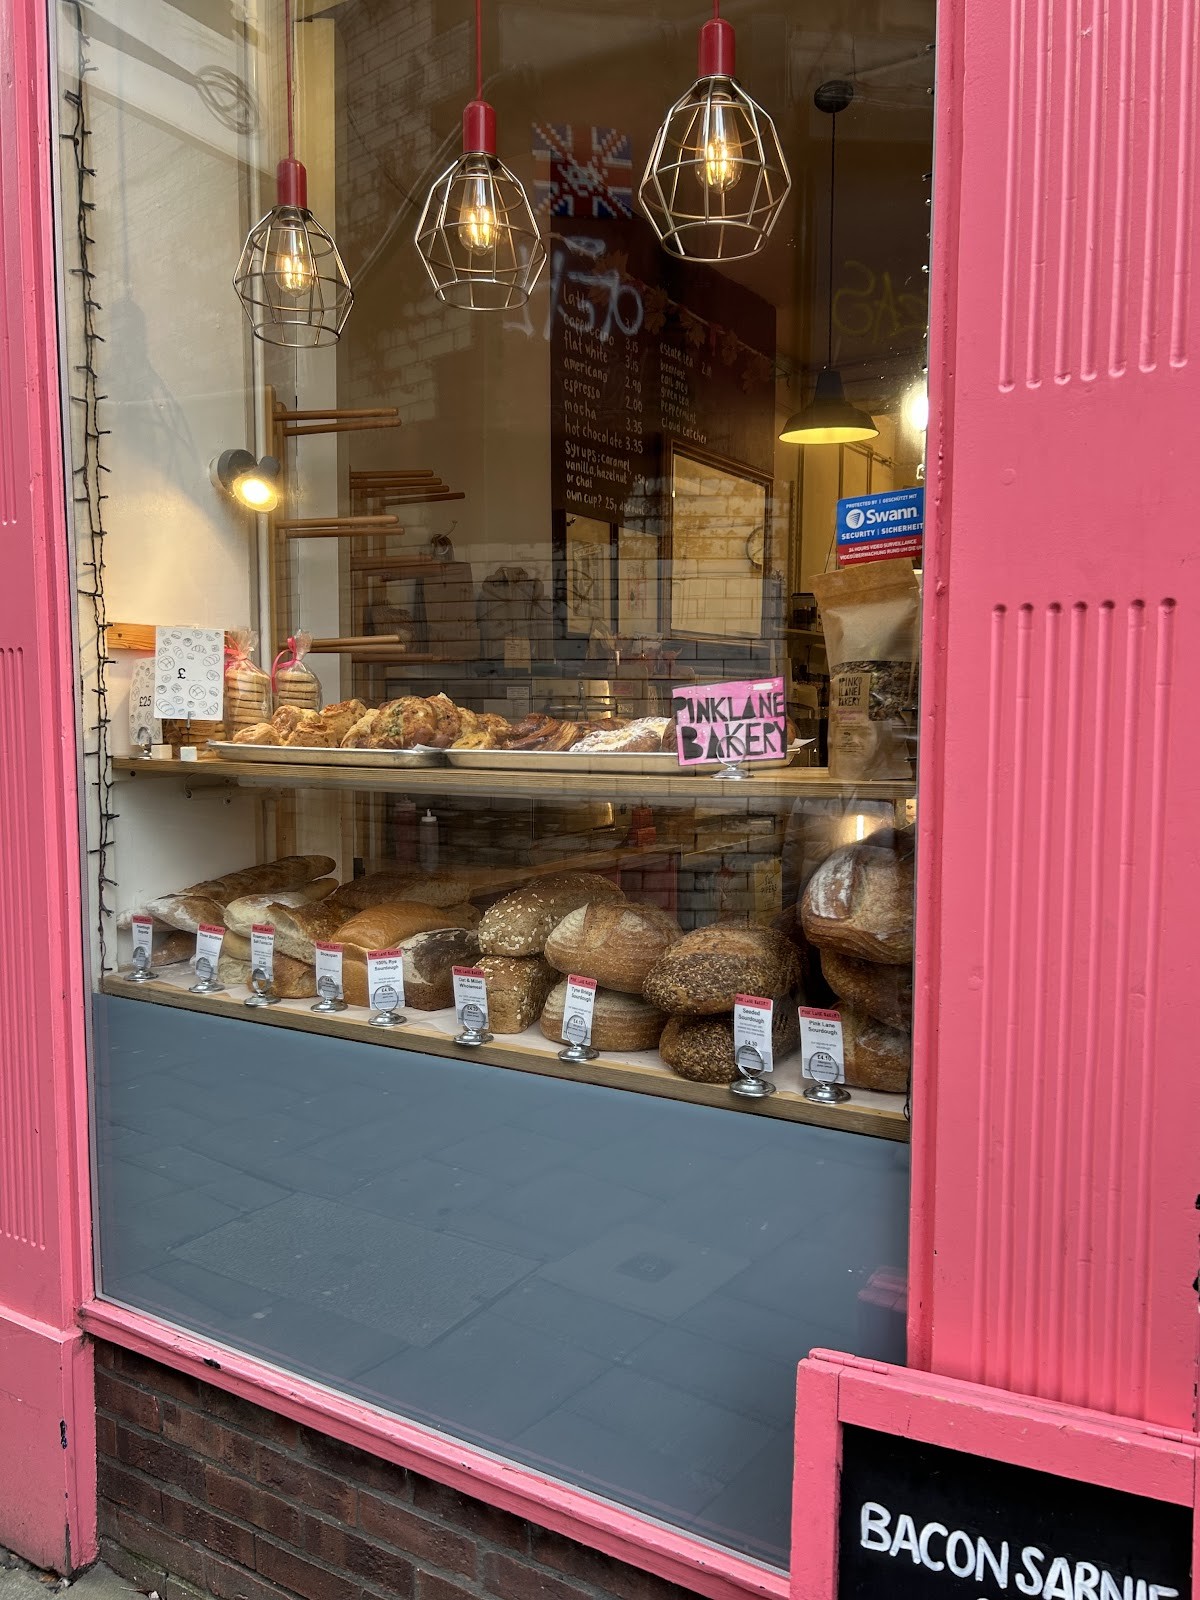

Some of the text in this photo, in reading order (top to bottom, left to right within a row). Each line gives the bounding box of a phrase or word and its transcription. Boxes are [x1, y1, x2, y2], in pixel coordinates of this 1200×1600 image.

[564, 329, 583, 355] flat
[585, 339, 608, 364] white
[563, 357, 608, 383] americano
[563, 378, 643, 413] espresso 2.00
[564, 399, 643, 435] mocha 3.35
[661, 416, 681, 433] cloud
[564, 414, 644, 454] hot chocolate 3.35
[566, 473, 593, 489] or chai
[566, 488, 582, 502] own
[583, 493, 603, 509] cup?
[846, 501, 871, 509] PROTECTED
[866, 506, 917, 525] Swann
[841, 522, 924, 541] SECURITY SICHERHEIT
[854, 544, 869, 552] HOURS
[870, 542, 883, 550] VIDEO
[884, 539, 917, 548] SURVEILLANCE
[177, 667, 186, 679] £
[139, 695, 152, 708] £25
[838, 696, 861, 707] BAKERY
[680, 721, 787, 761] BAKERY
[571, 993, 592, 1003] Sourdough
[738, 1014, 764, 1024] Sourdough
[742, 1008, 760, 1016] Seeded
[808, 1026, 838, 1036] Sourdough
[821, 1021, 836, 1029] Lane
[860, 1501, 1009, 1589] BACON
